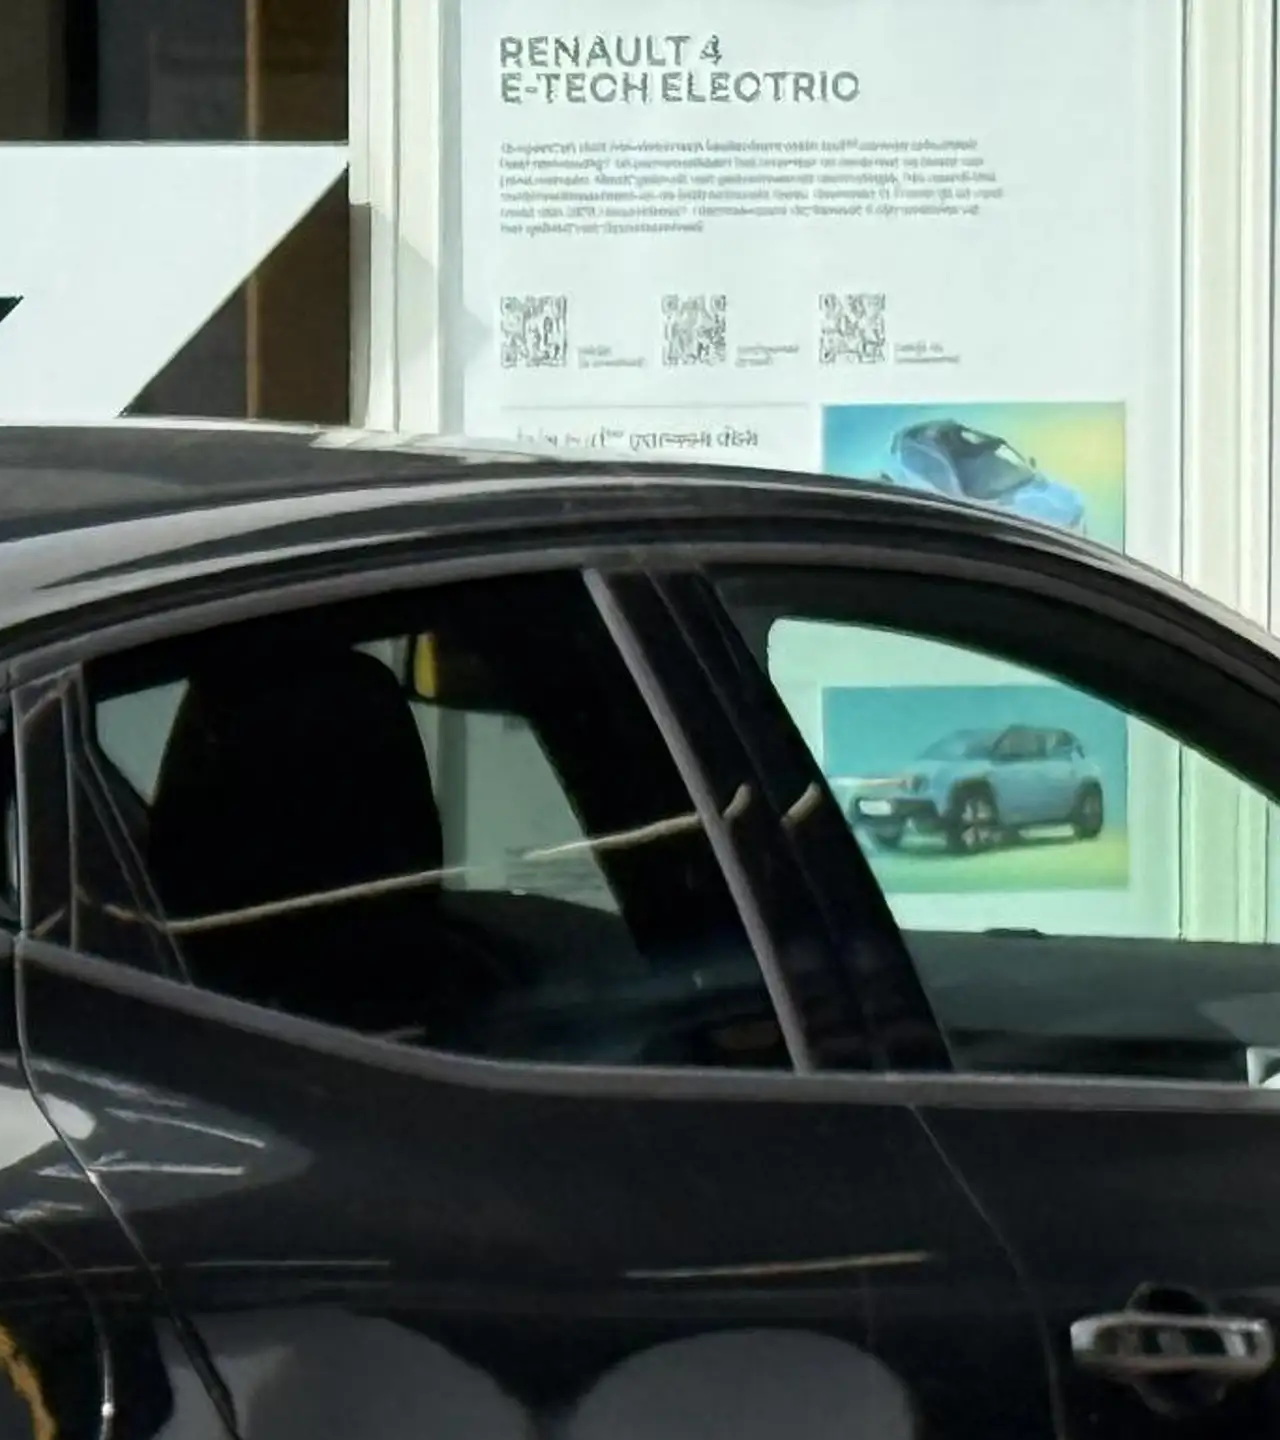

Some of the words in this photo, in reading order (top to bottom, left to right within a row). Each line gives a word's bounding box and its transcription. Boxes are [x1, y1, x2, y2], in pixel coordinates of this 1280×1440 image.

[499, 34, 691, 68] RENAULT
[698, 34, 723, 64] 4
[500, 72, 649, 104] E-TECH
[660, 70, 861, 103] ELECTRIC
